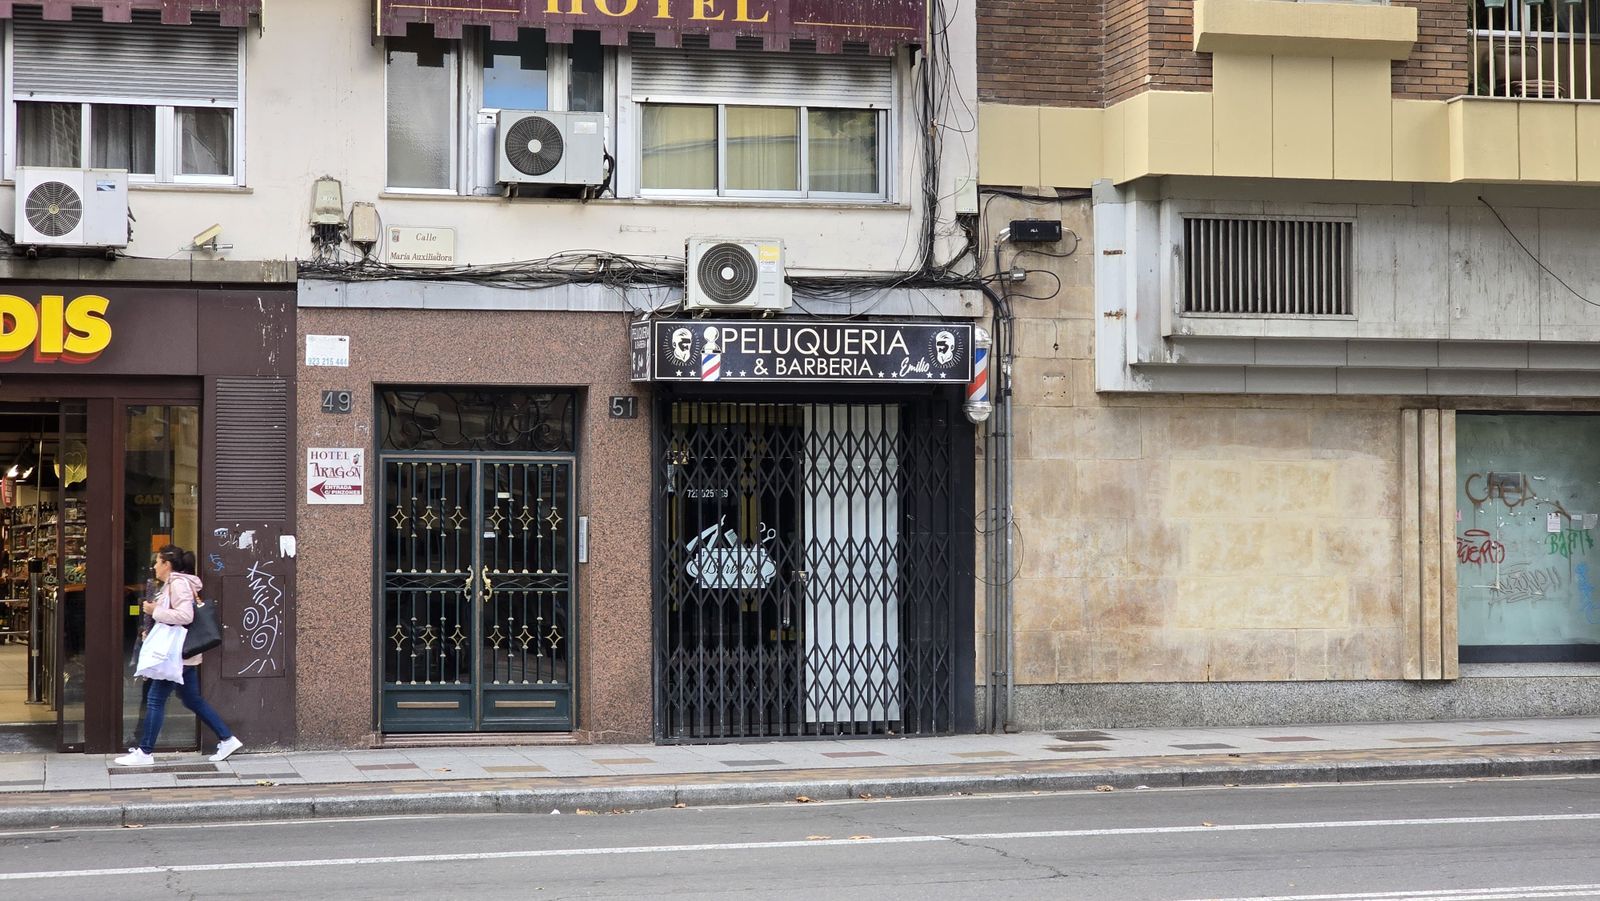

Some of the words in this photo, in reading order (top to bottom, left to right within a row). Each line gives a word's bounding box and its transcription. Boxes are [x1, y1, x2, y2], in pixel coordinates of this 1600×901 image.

[415, 232, 437, 242] Calle
[411, 251, 452, 261] Auxiliadora
[722, 327, 909, 356] PELUQUERIA
[308, 357, 320, 365] 923
[754, 358, 768, 375] &
[776, 358, 873, 376] BARBERIA
[900, 357, 930, 378] Emilio
[322, 391, 350, 411] 49
[612, 397, 633, 416] 51
[310, 451, 349, 460] HOTEL
